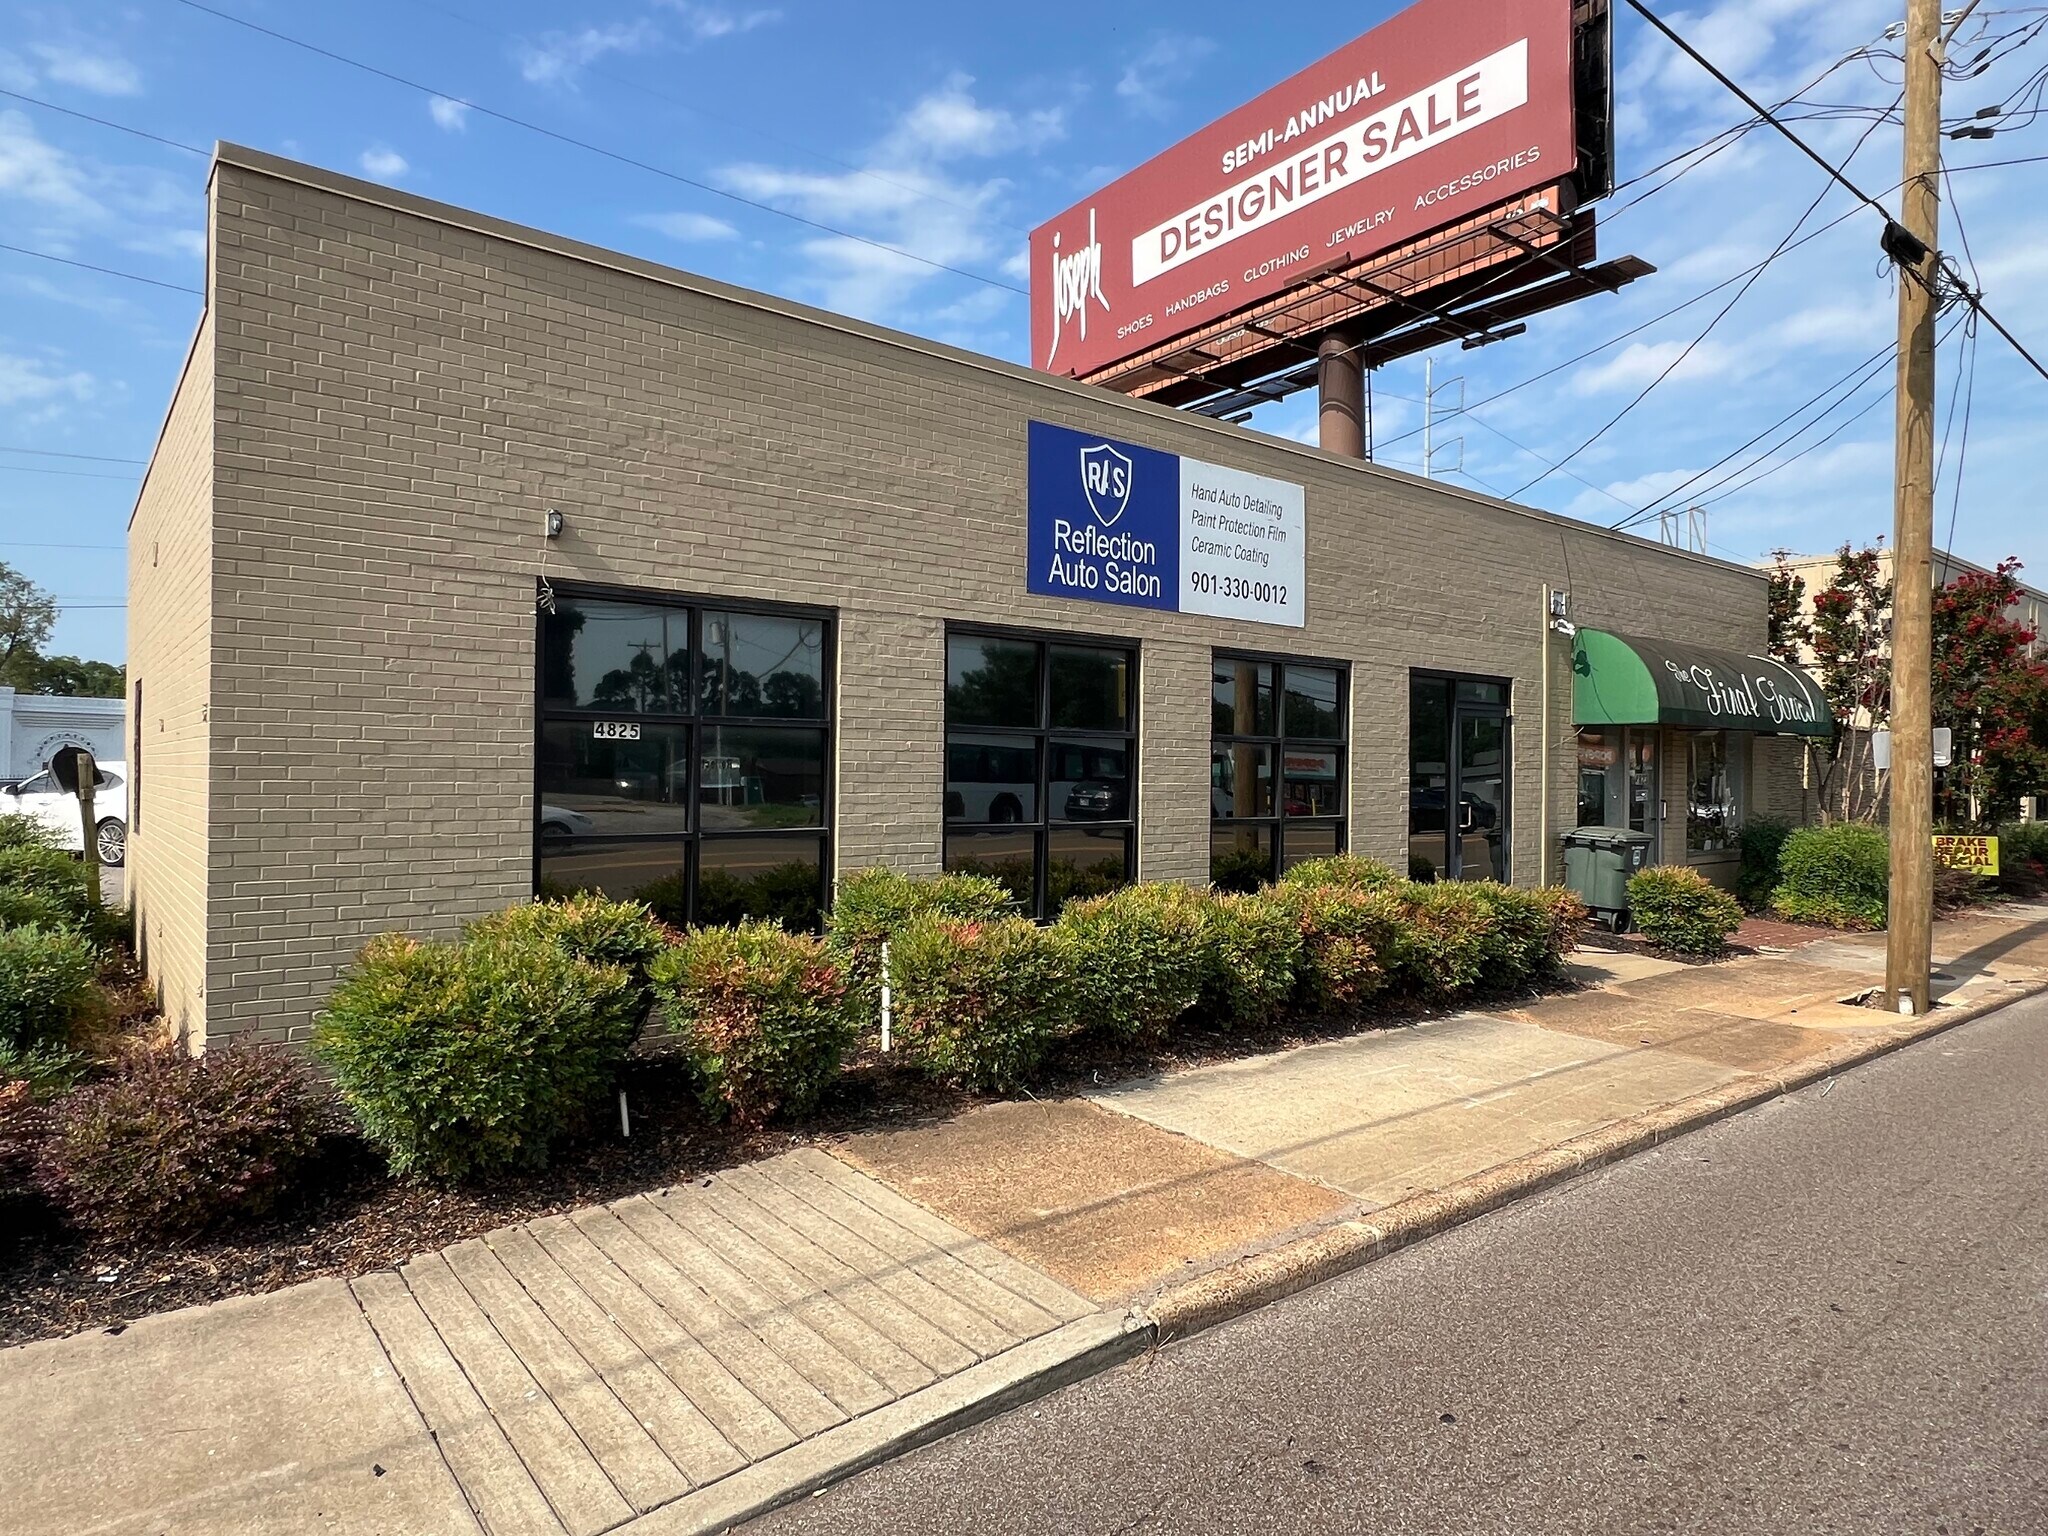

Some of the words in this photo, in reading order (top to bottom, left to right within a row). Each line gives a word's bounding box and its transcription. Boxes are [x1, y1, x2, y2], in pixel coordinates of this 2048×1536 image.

[1222, 71, 1386, 174] SEMI-ANNUAL
[1161, 147, 1348, 263] DESIGNER
[1362, 71, 1483, 164] SALE
[1117, 314, 1153, 339] SHOES
[1165, 280, 1230, 318] HANDBAGS
[1243, 245, 1310, 283] CLOTHING
[1325, 207, 1396, 248] JEWELRY
[1414, 146, 1541, 210] ACCESSORIES
[1047, 208, 1111, 370] joseph
[1191, 483, 1217, 503] Hand
[1219, 490, 1240, 509] Auto
[1243, 495, 1283, 520] Detailing
[1055, 519, 1155, 566] Reflection
[1191, 510, 1217, 529] Paint
[1219, 516, 1265, 538] Protection
[1268, 524, 1287, 543] Film
[1191, 537, 1231, 559] Ceramic
[1234, 543, 1269, 567] Coating
[1048, 553, 1099, 590] Auto
[1105, 562, 1161, 599] Salon
[1191, 571, 1287, 606] 901-330-0012
[1665, 660, 1691, 683] The
[1690, 665, 1760, 718] Final
[595, 723, 639, 738] 4825
[1935, 847, 1989, 857] REPAIR
[1936, 837, 1987, 847] BRAKE
